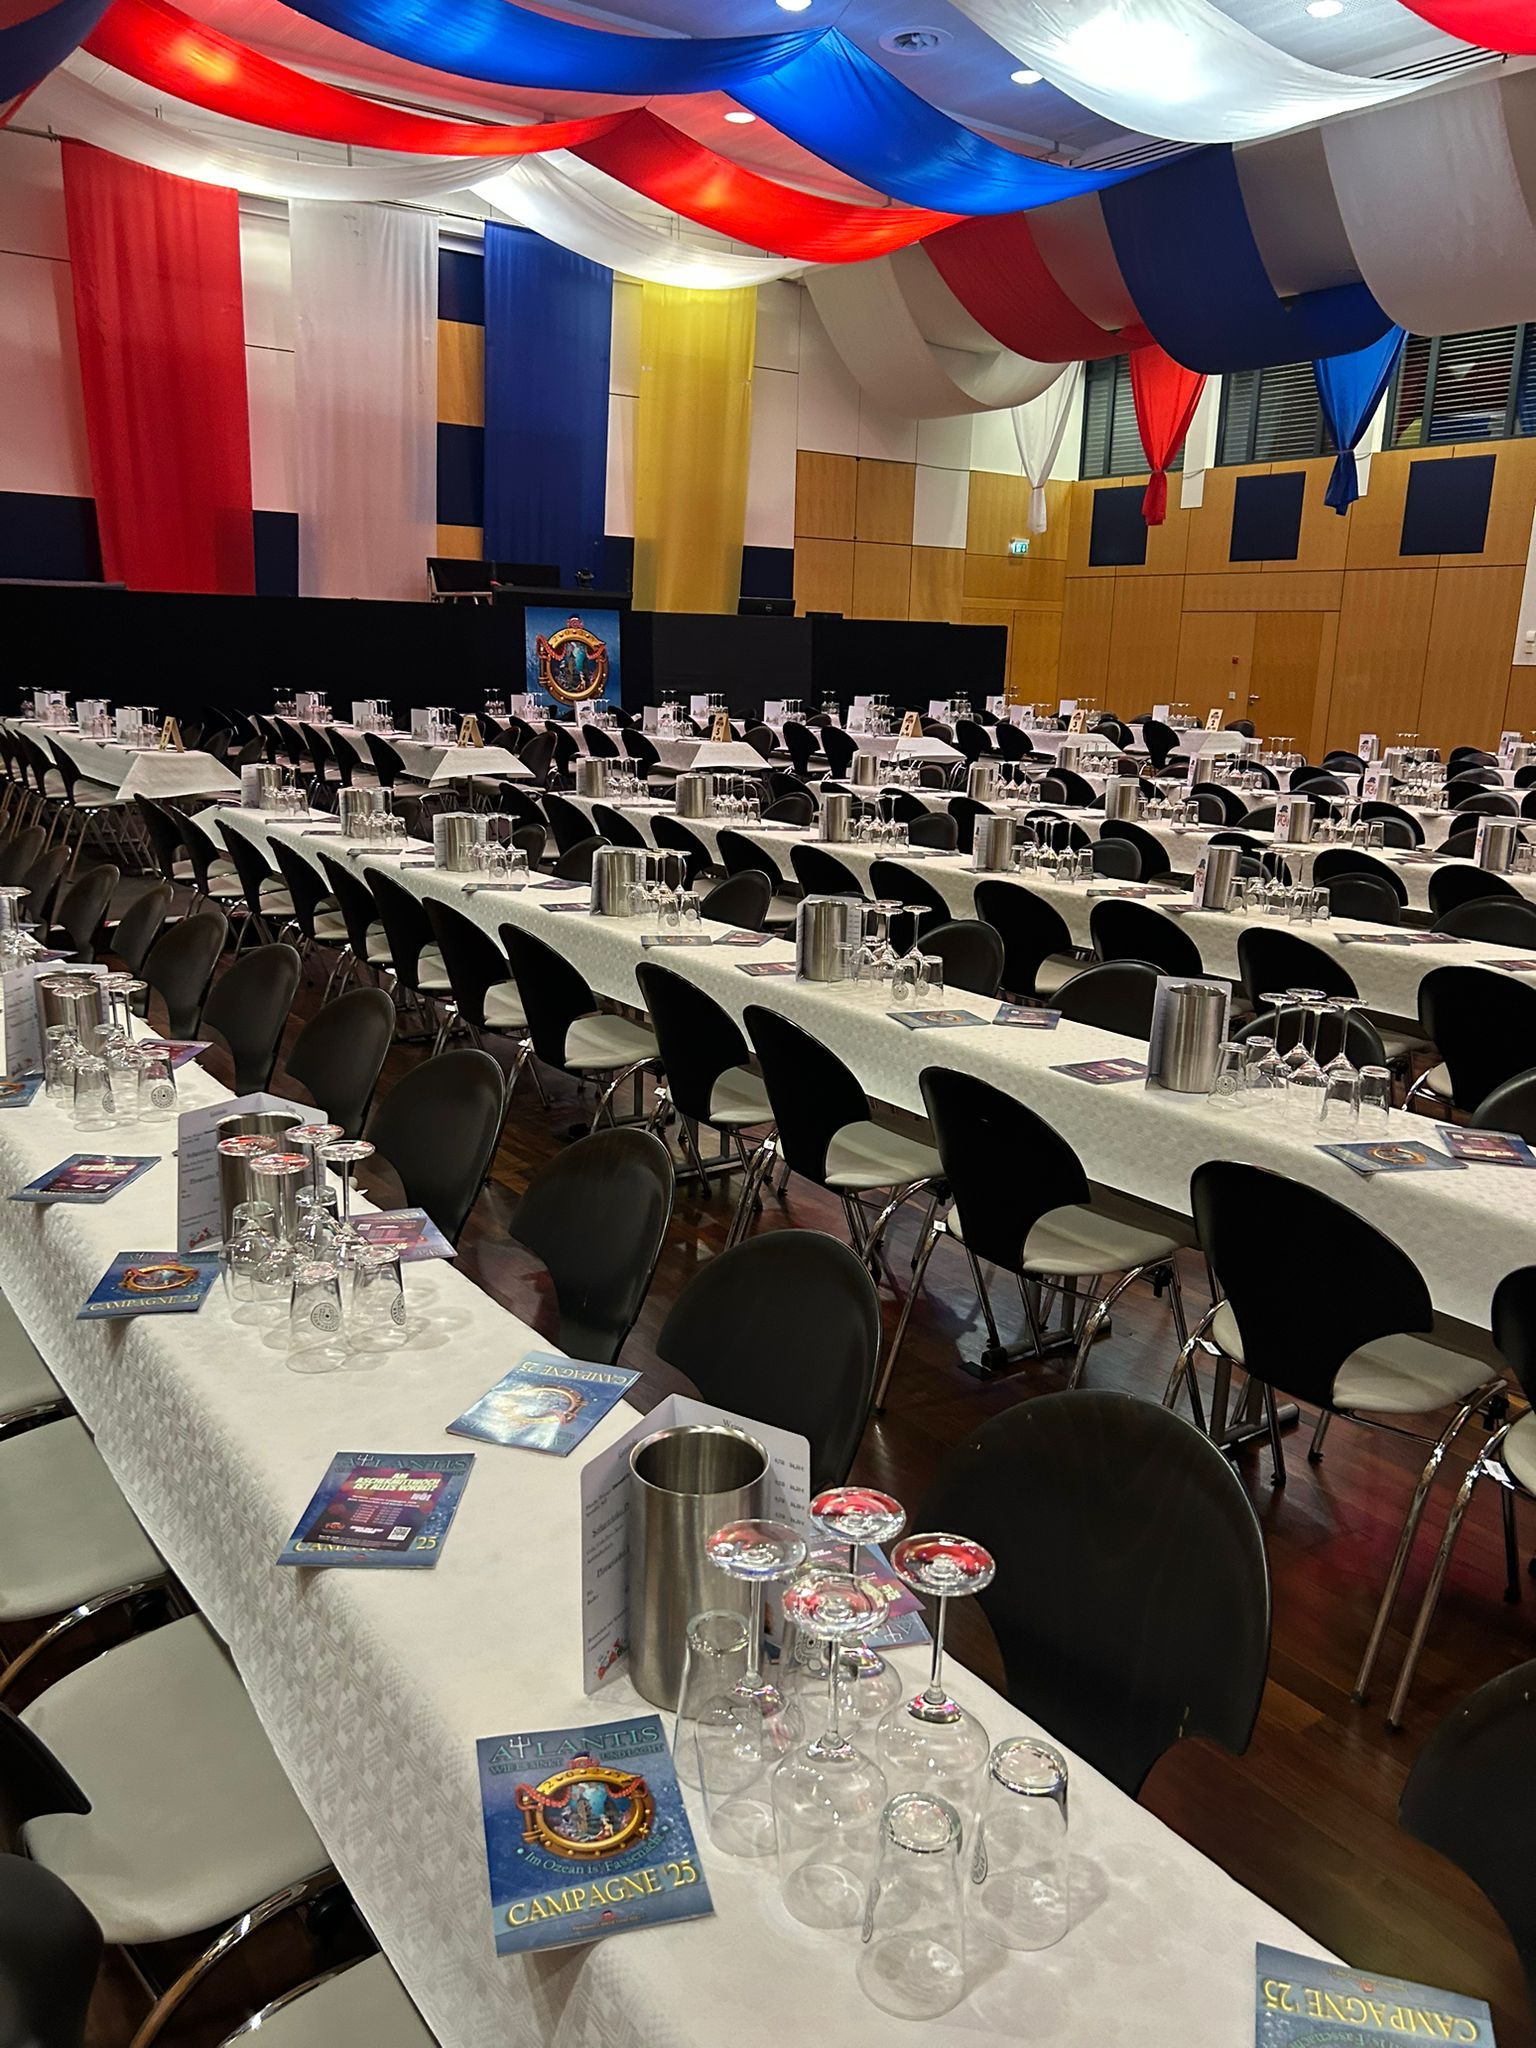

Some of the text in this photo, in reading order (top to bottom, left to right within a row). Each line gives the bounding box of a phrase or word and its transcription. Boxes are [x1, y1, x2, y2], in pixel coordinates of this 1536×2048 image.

[489, 1726, 660, 1764] ATLANTIS
[525, 1851, 541, 1866] Im
[543, 1860, 585, 1875] Ozean
[604, 1833, 666, 1872] Fassenacht
[507, 1868, 663, 1927] CAMPAGNE
[1304, 1988, 1479, 2043] CAMPAGNE
